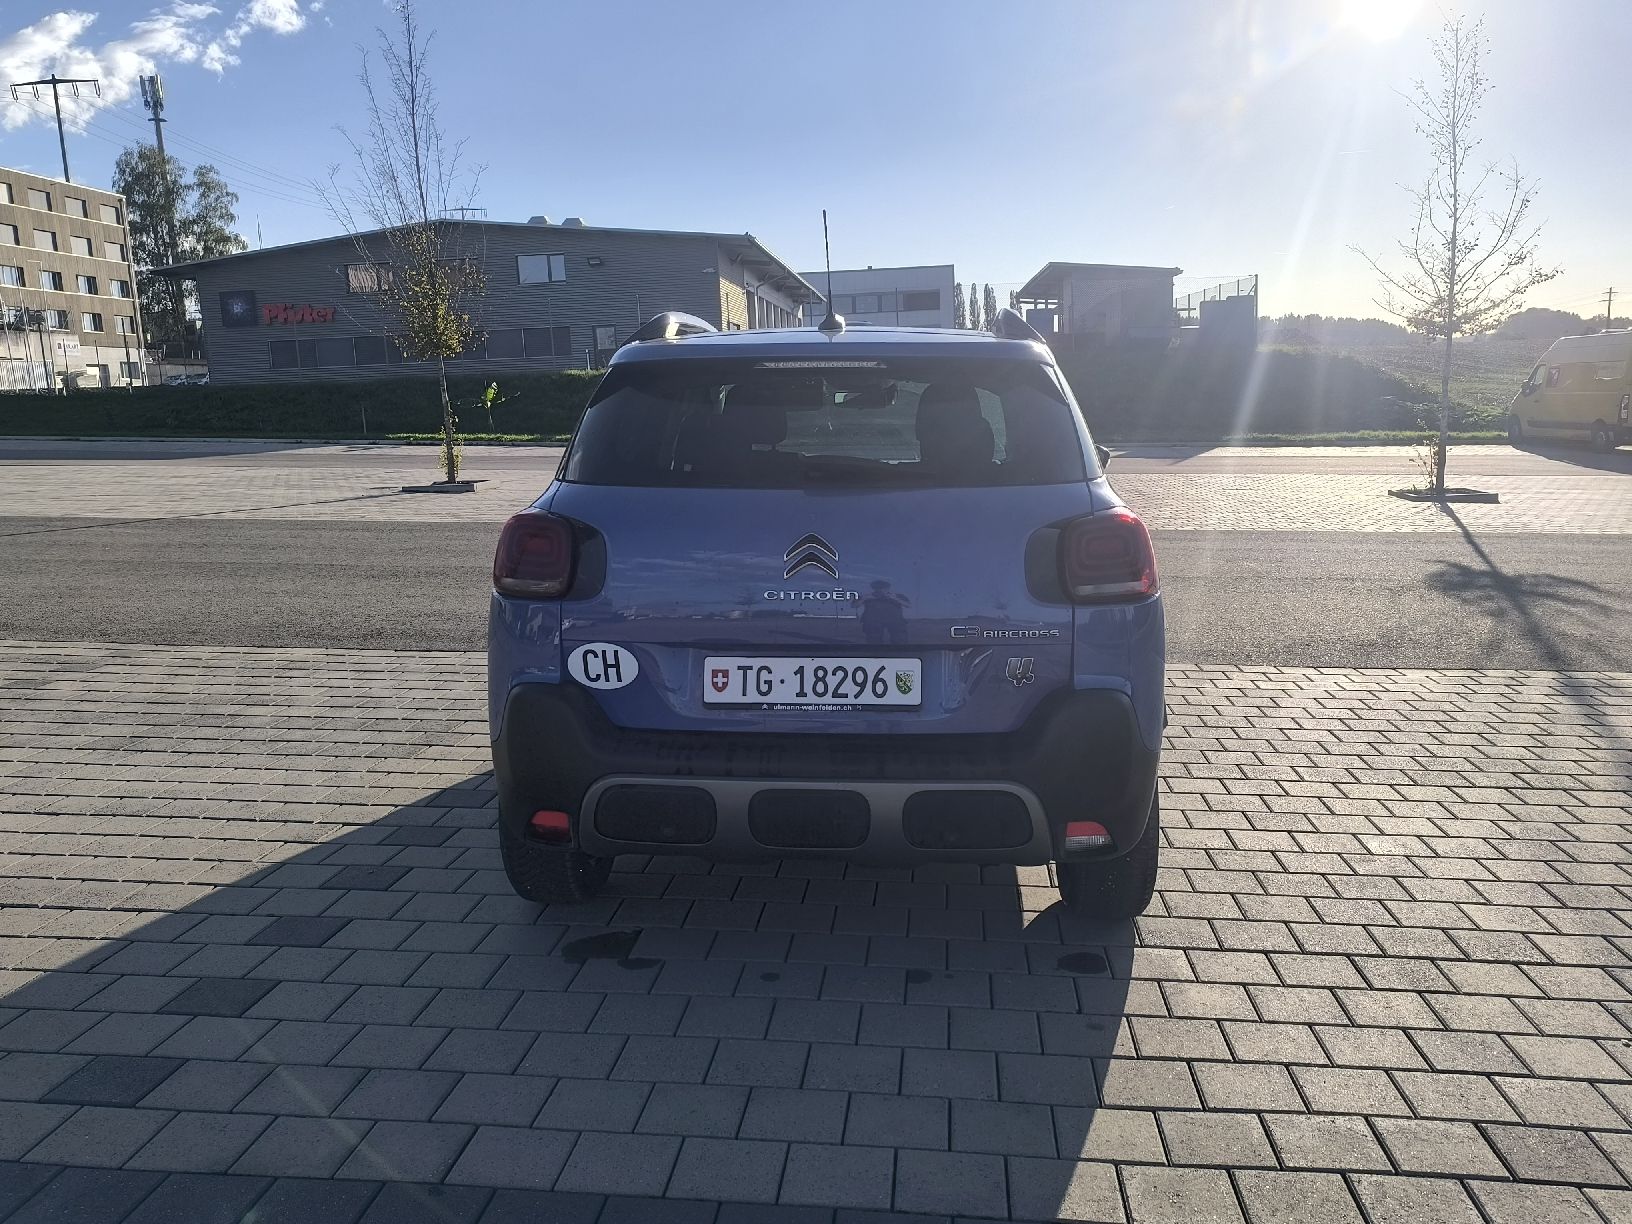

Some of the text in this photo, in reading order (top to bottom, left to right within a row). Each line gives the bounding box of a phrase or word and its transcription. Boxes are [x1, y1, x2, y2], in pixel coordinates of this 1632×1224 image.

[950, 626, 1060, 638] C3 AIRCROSS
[582, 649, 622, 682] CH
